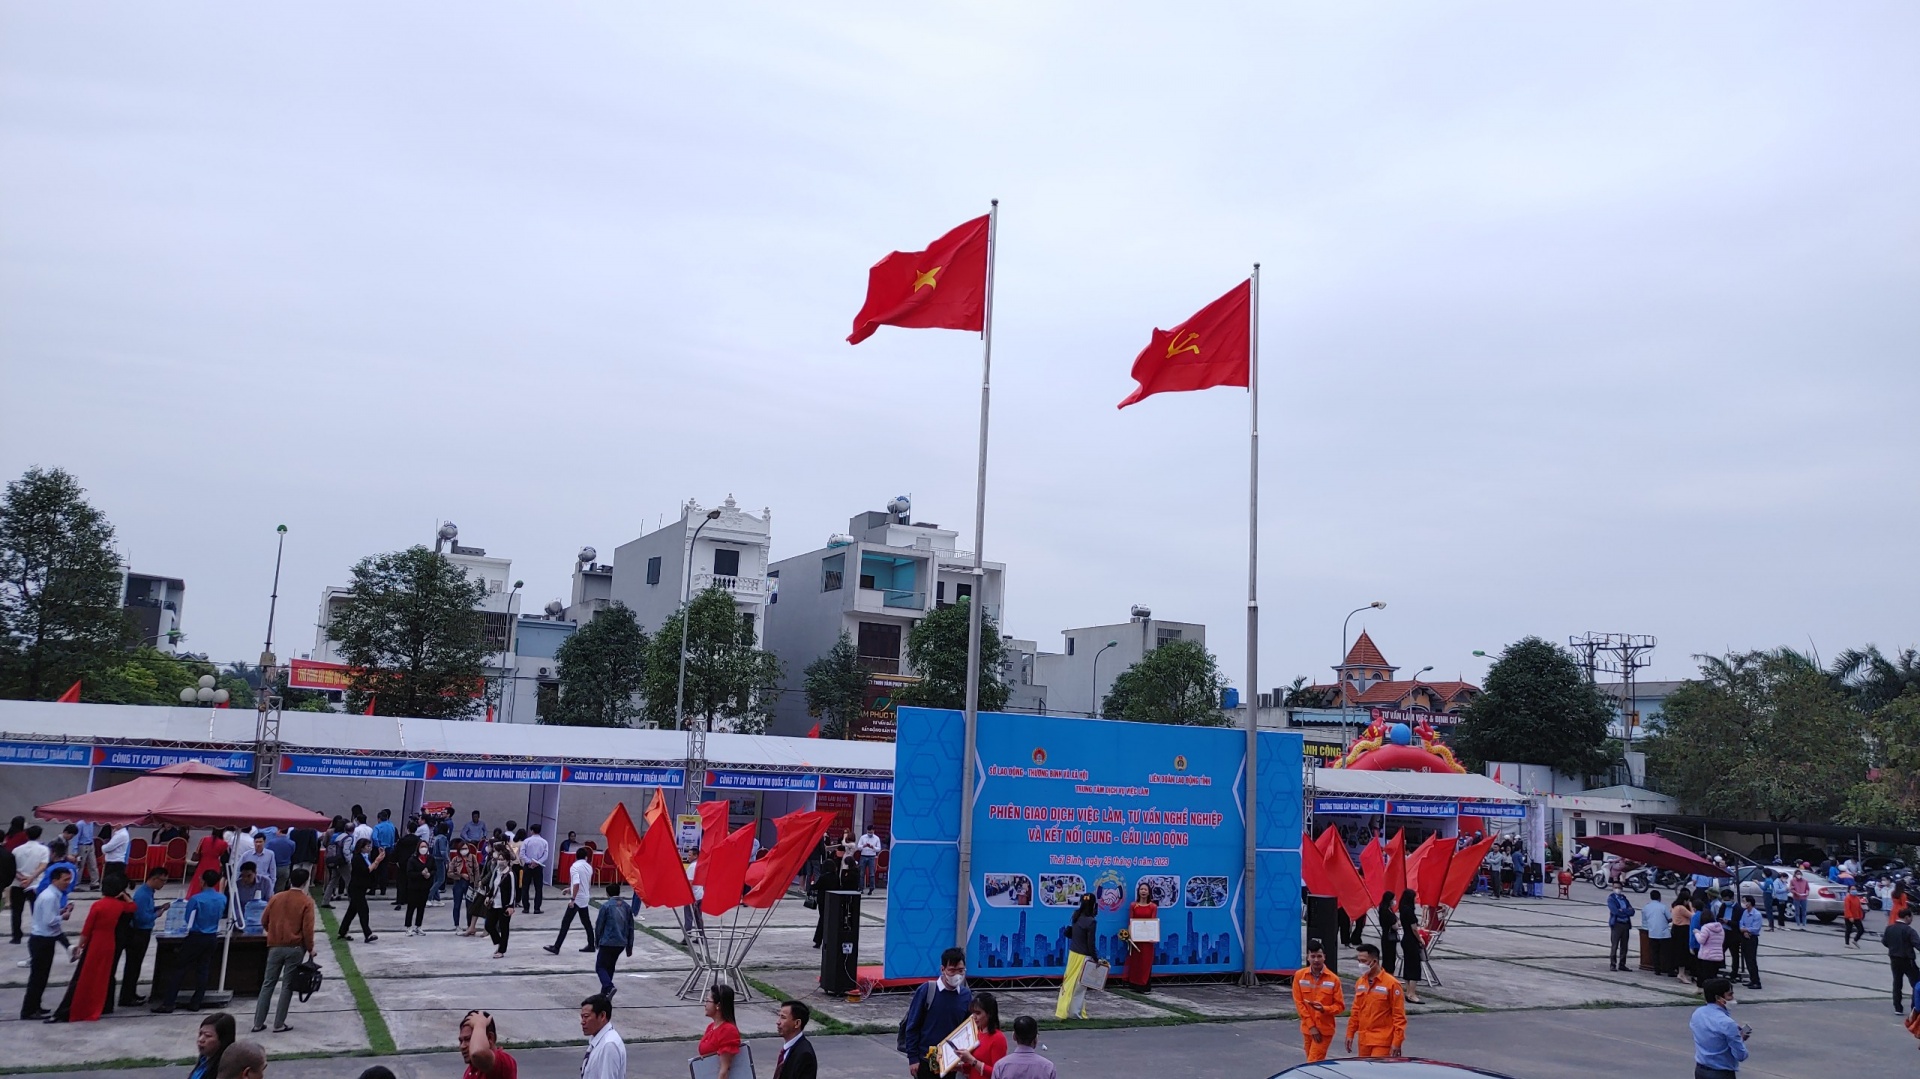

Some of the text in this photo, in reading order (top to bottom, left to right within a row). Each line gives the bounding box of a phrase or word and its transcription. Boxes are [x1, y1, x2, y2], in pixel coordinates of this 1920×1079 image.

[1320, 745, 1341, 757] CÔNG
[112, 752, 131, 764] CÔNG
[132, 755, 140, 764] TY
[230, 758, 247, 768] PHÁT
[443, 767, 457, 778] CÔNG
[459, 769, 466, 778] TY
[466, 769, 474, 778] CP
[501, 768, 514, 779] PHÁT
[574, 770, 589, 780] CÔNG
[590, 772, 596, 780] TY
[596, 772, 604, 781] CP
[997, 766, 1008, 776] LAO
[1008, 766, 1024, 778] ĐỘNG
[1079, 769, 1089, 782] HỘI
[720, 775, 733, 785] CÔNG
[734, 776, 740, 785] TY
[740, 777, 746, 786] CP
[834, 779, 848, 789] CÔNG
[856, 781, 869, 790] TNHH
[870, 782, 880, 790] BAO
[1149, 773, 1161, 783] LIÊN
[1185, 774, 1199, 787] ĐỘNG
[1075, 785, 1093, 794] TRUNG
[1094, 784, 1105, 794] TÂM
[1105, 786, 1118, 796] DỊCH
[1126, 786, 1138, 797] VIỆC
[989, 802, 1223, 830] PHIÊN GIAO DỊCH VIỆC LÀM, TƯ VẤN NGHỀ NGHIỆP
[1028, 825, 1042, 842] VÀ
[1044, 824, 1064, 842] KẾT
[1065, 825, 1082, 843] NỐI
[1085, 830, 1112, 846] CUNG
[1143, 830, 1161, 846] LAO
[1163, 829, 1188, 848] ĐỘNG
[1050, 854, 1064, 865] Thái
[1085, 855, 1102, 868] ngày
[1112, 855, 1132, 868] tháng
[1153, 857, 1170, 867] 2023
